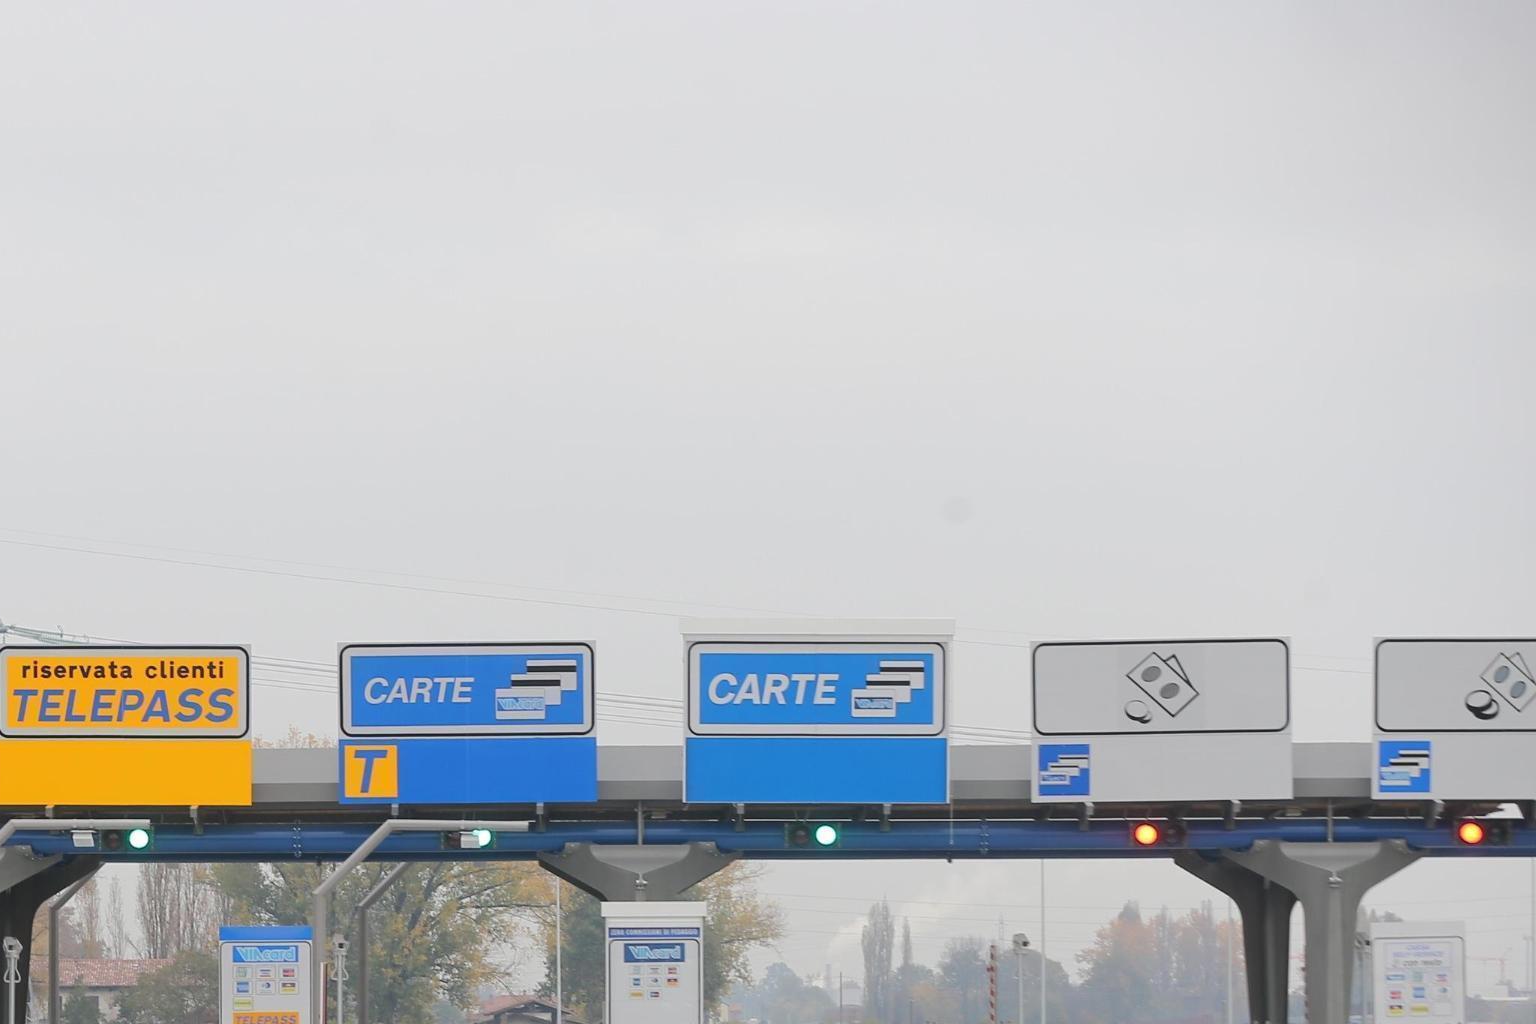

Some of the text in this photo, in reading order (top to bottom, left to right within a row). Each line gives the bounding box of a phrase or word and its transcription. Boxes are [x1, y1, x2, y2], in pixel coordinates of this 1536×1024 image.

[21, 660, 225, 679] riservata clienti
[12, 687, 235, 724] TELEPASS
[363, 676, 475, 705] CARTE
[707, 673, 840, 706] CARTE
[353, 749, 389, 794] T
